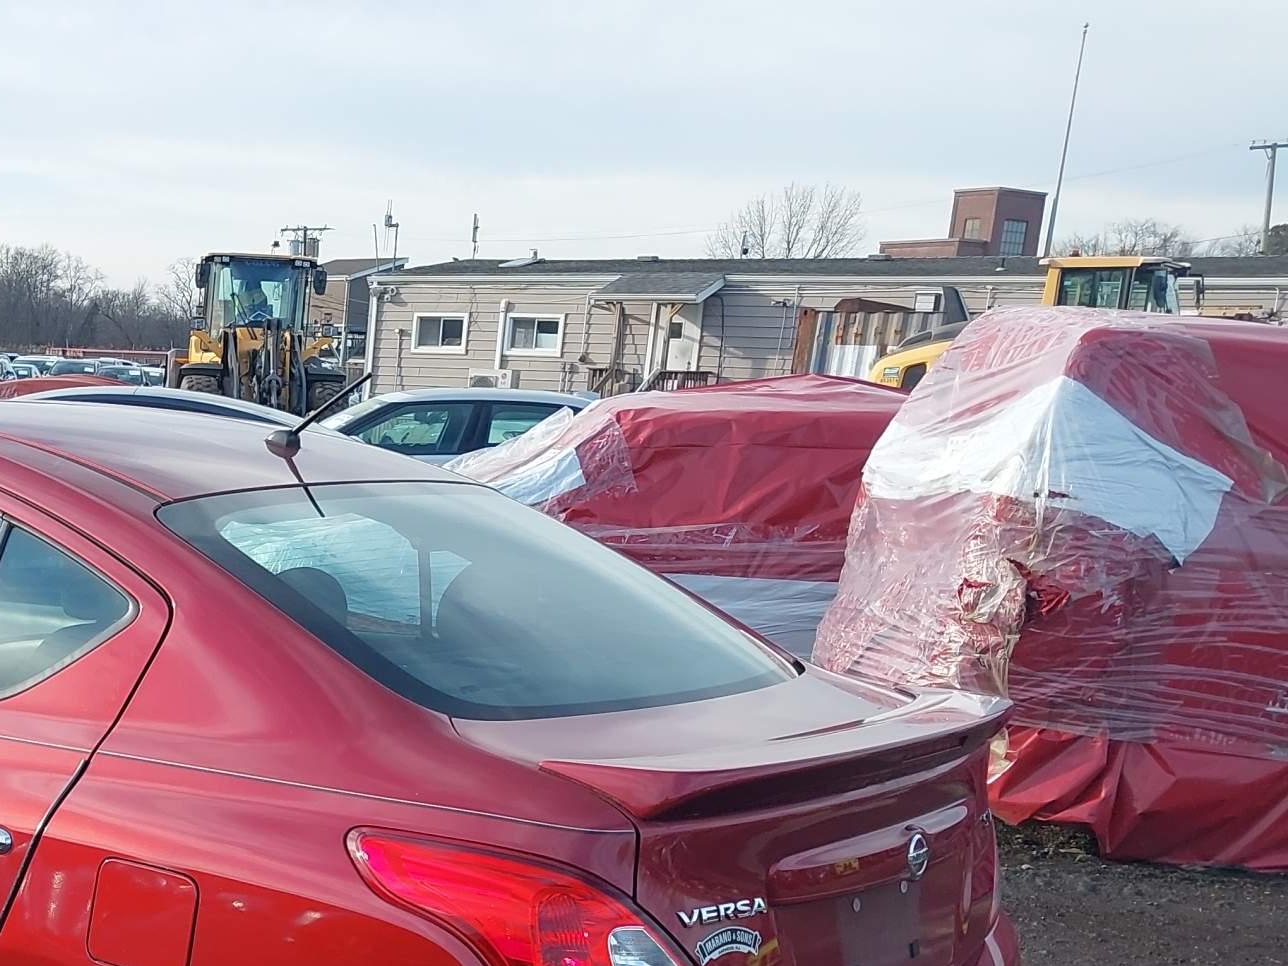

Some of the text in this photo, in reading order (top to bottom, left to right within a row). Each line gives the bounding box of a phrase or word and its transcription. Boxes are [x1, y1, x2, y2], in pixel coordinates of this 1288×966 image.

[675, 897, 767, 928] VERSA
[705, 930, 732, 954] MARANO
[736, 930, 753, 945] SONS
